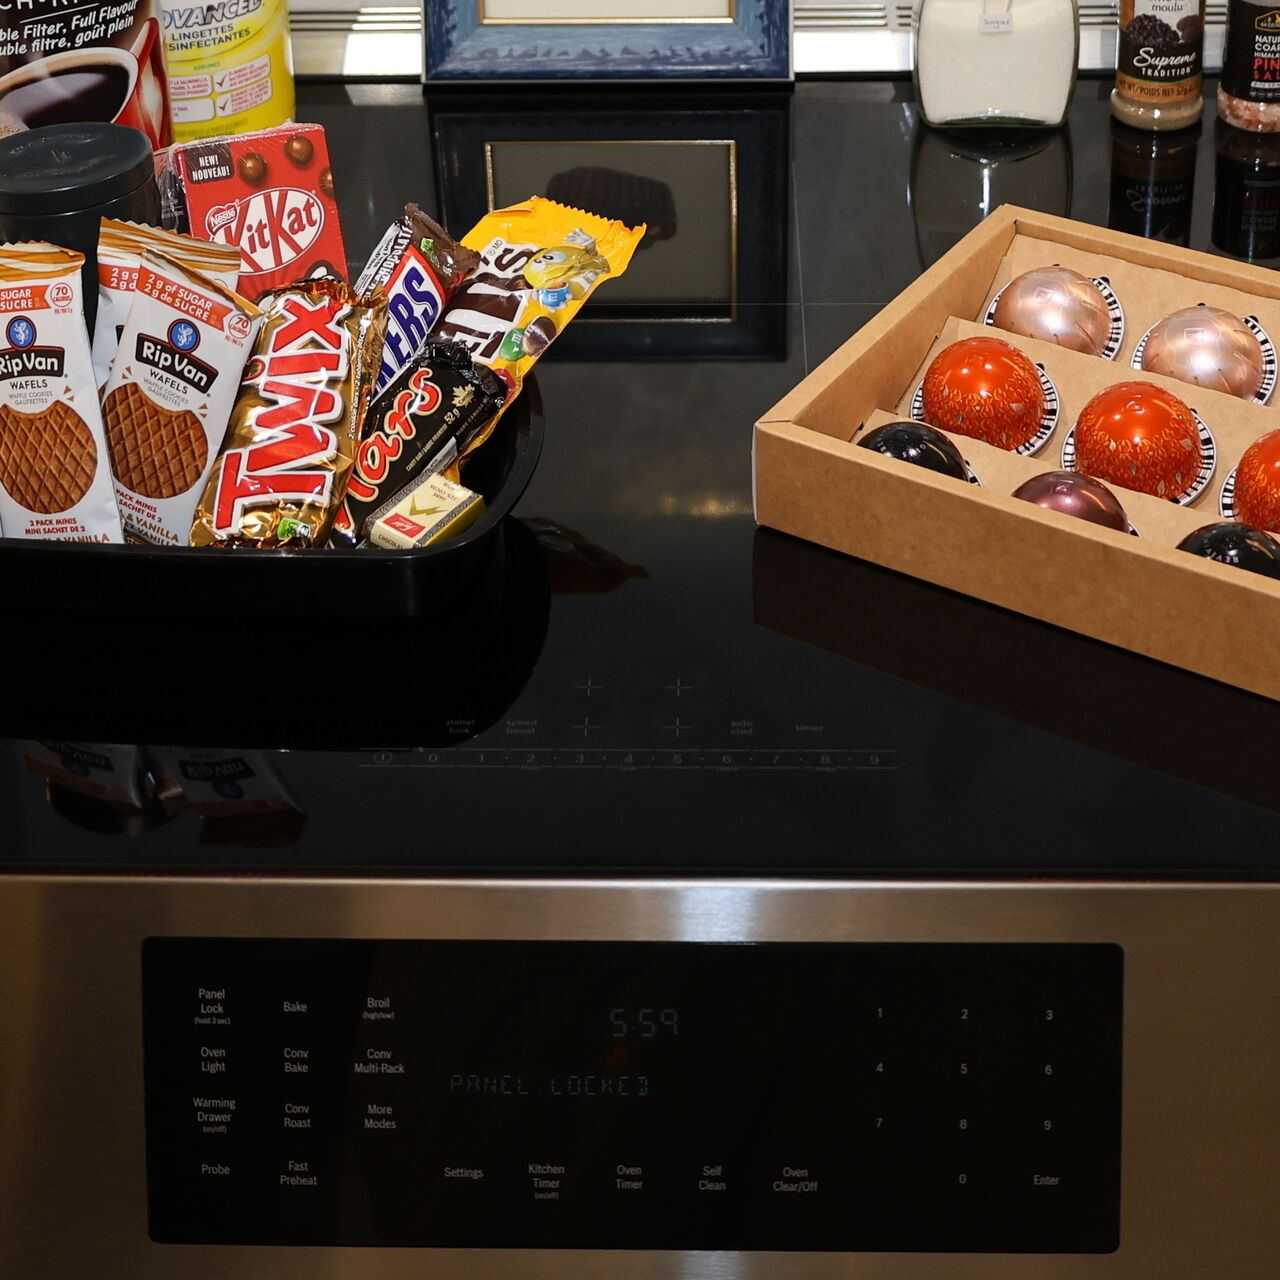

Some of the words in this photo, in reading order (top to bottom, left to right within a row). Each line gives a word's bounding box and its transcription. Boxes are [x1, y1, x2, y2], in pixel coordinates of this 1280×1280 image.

[1151, 3, 1183, 12] moulu
[24, 22, 67, 38] Filter,
[71, 11, 97, 30] Full
[32, 35, 71, 52] filtre,
[75, 25, 106, 47] goût
[107, 15, 134, 39] plein
[172, 23, 234, 41] LINGETTES
[1133, 47, 1197, 70] Supreme
[1141, 67, 1191, 77] TRADITION
[199, 155, 219, 167] NEW!
[192, 166, 230, 180] NOUVEAU!
[210, 208, 236, 227] Nestlé
[224, 190, 318, 271] KitKat
[0, 290, 32, 300] SUGAR
[55, 286, 68, 296] 70
[148, 274, 155, 283] 2
[156, 278, 163, 289] g
[165, 283, 178, 294] of
[178, 288, 213, 310] SUGAR
[0, 299, 33, 310] SUCRE
[145, 284, 151, 293] 2
[152, 288, 159, 298] g
[160, 292, 172, 303] de
[174, 298, 210, 320] SUCRE
[237, 317, 249, 328] 70
[9, 379, 48, 390] WAFELS
[150, 369, 188, 395] WAFELS
[350, 406, 358, 431] cookie
[443, 412, 456, 424] 52
[453, 408, 461, 418] g
[348, 432, 355, 440] 2
[116, 489, 134, 503] PACK
[135, 500, 157, 513] MINIS
[119, 499, 145, 515] SACHET
[146, 512, 156, 521] DE
[35, 519, 55, 527] PACK
[136, 516, 179, 542] VANILLA
[795, 724, 823, 732] timer
[198, 988, 226, 999] Panel
[283, 1001, 308, 1013] Bake
[367, 997, 390, 1008] Broil
[201, 1003, 224, 1014] Lock
[877, 1008, 883, 1018] 1
[960, 1008, 969, 1020] 2
[1045, 1009, 1054, 1021] 3
[610, 1008, 678, 1038] 5:59
[201, 1047, 226, 1058] Oven
[284, 1048, 309, 1058] Conv
[367, 1049, 392, 1059] Conv
[201, 1061, 226, 1073] Light
[284, 1062, 309, 1073] Bake
[354, 1063, 405, 1074] Multi-Rack
[875, 1062, 884, 1072] 4
[960, 1063, 968, 1074] 5
[1044, 1064, 1053, 1075] 6
[450, 1074, 528, 1095] PANEL
[550, 1076, 648, 1096] LOCKED
[192, 1097, 236, 1111] Warming
[285, 1104, 310, 1114] Conv
[368, 1104, 392, 1115] More
[197, 1112, 232, 1122] Drawer
[875, 1117, 883, 1128] 7
[284, 1118, 311, 1129] Roast
[364, 1118, 397, 1129] Modes
[959, 1119, 968, 1130] 8
[1043, 1120, 1052, 1131] 9
[201, 1164, 231, 1175] Probe
[288, 1161, 309, 1171] Fast
[528, 1163, 565, 1175] Kitchen
[616, 1164, 642, 1176] Oven
[703, 1165, 722, 1176] Self
[444, 1167, 484, 1180] Settings
[783, 1166, 809, 1178] Oven
[280, 1175, 318, 1186] Preheat
[532, 1178, 560, 1189] Timer
[959, 1173, 967, 1184] 0
[1033, 1175, 1060, 1185] Enter
[615, 1179, 643, 1190] Timer
[698, 1180, 727, 1191] Clean
[773, 1180, 819, 1193] Clear/Off
